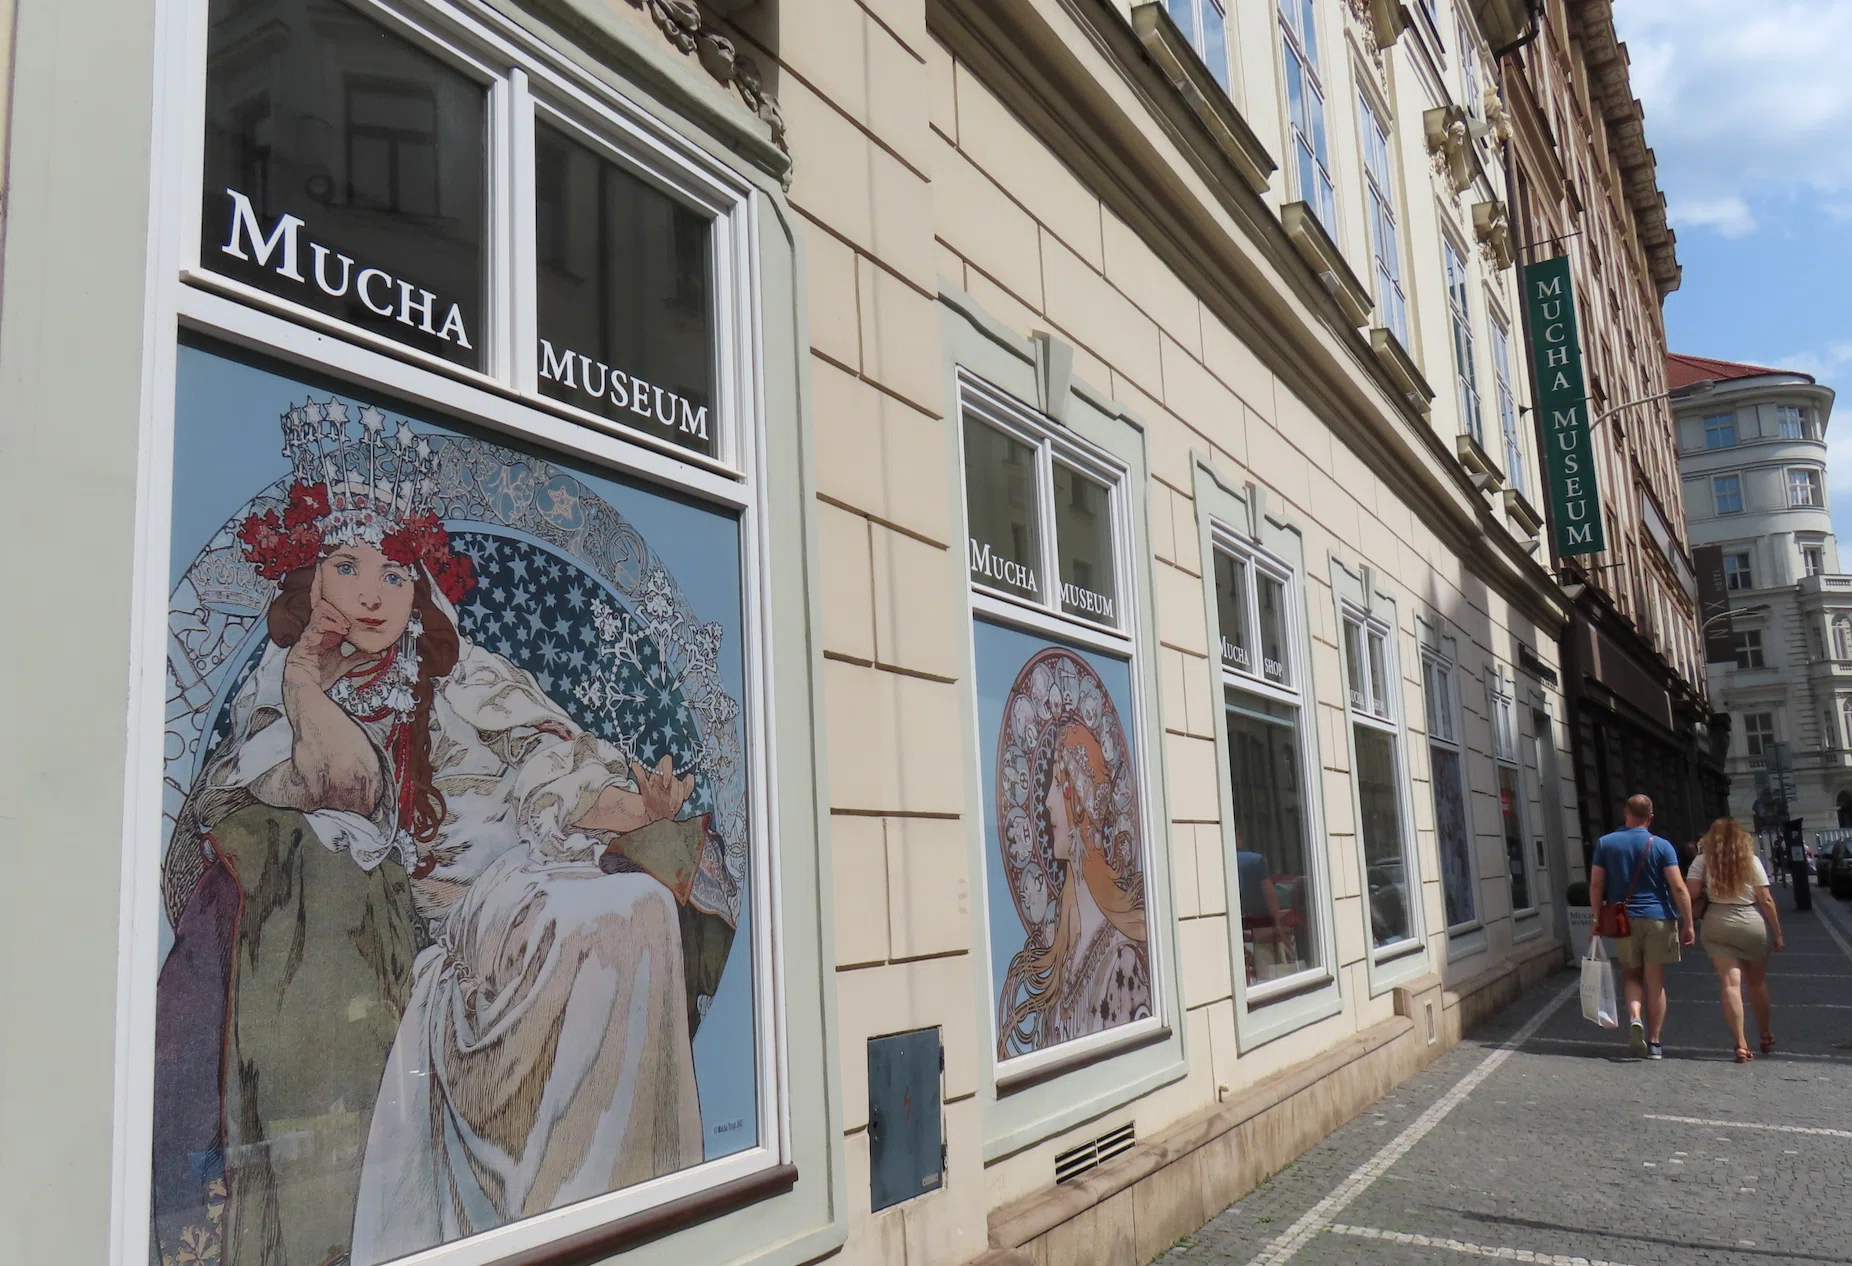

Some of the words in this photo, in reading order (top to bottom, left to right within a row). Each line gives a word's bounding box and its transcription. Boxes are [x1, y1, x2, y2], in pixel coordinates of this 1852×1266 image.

[1535, 275, 1571, 392] MUCHA
[538, 338, 710, 441] MUSEUM
[1552, 406, 1594, 546] MUSEUM
[1059, 581, 1114, 618] MUSEUM
[1264, 657, 1283, 677] SHOP
